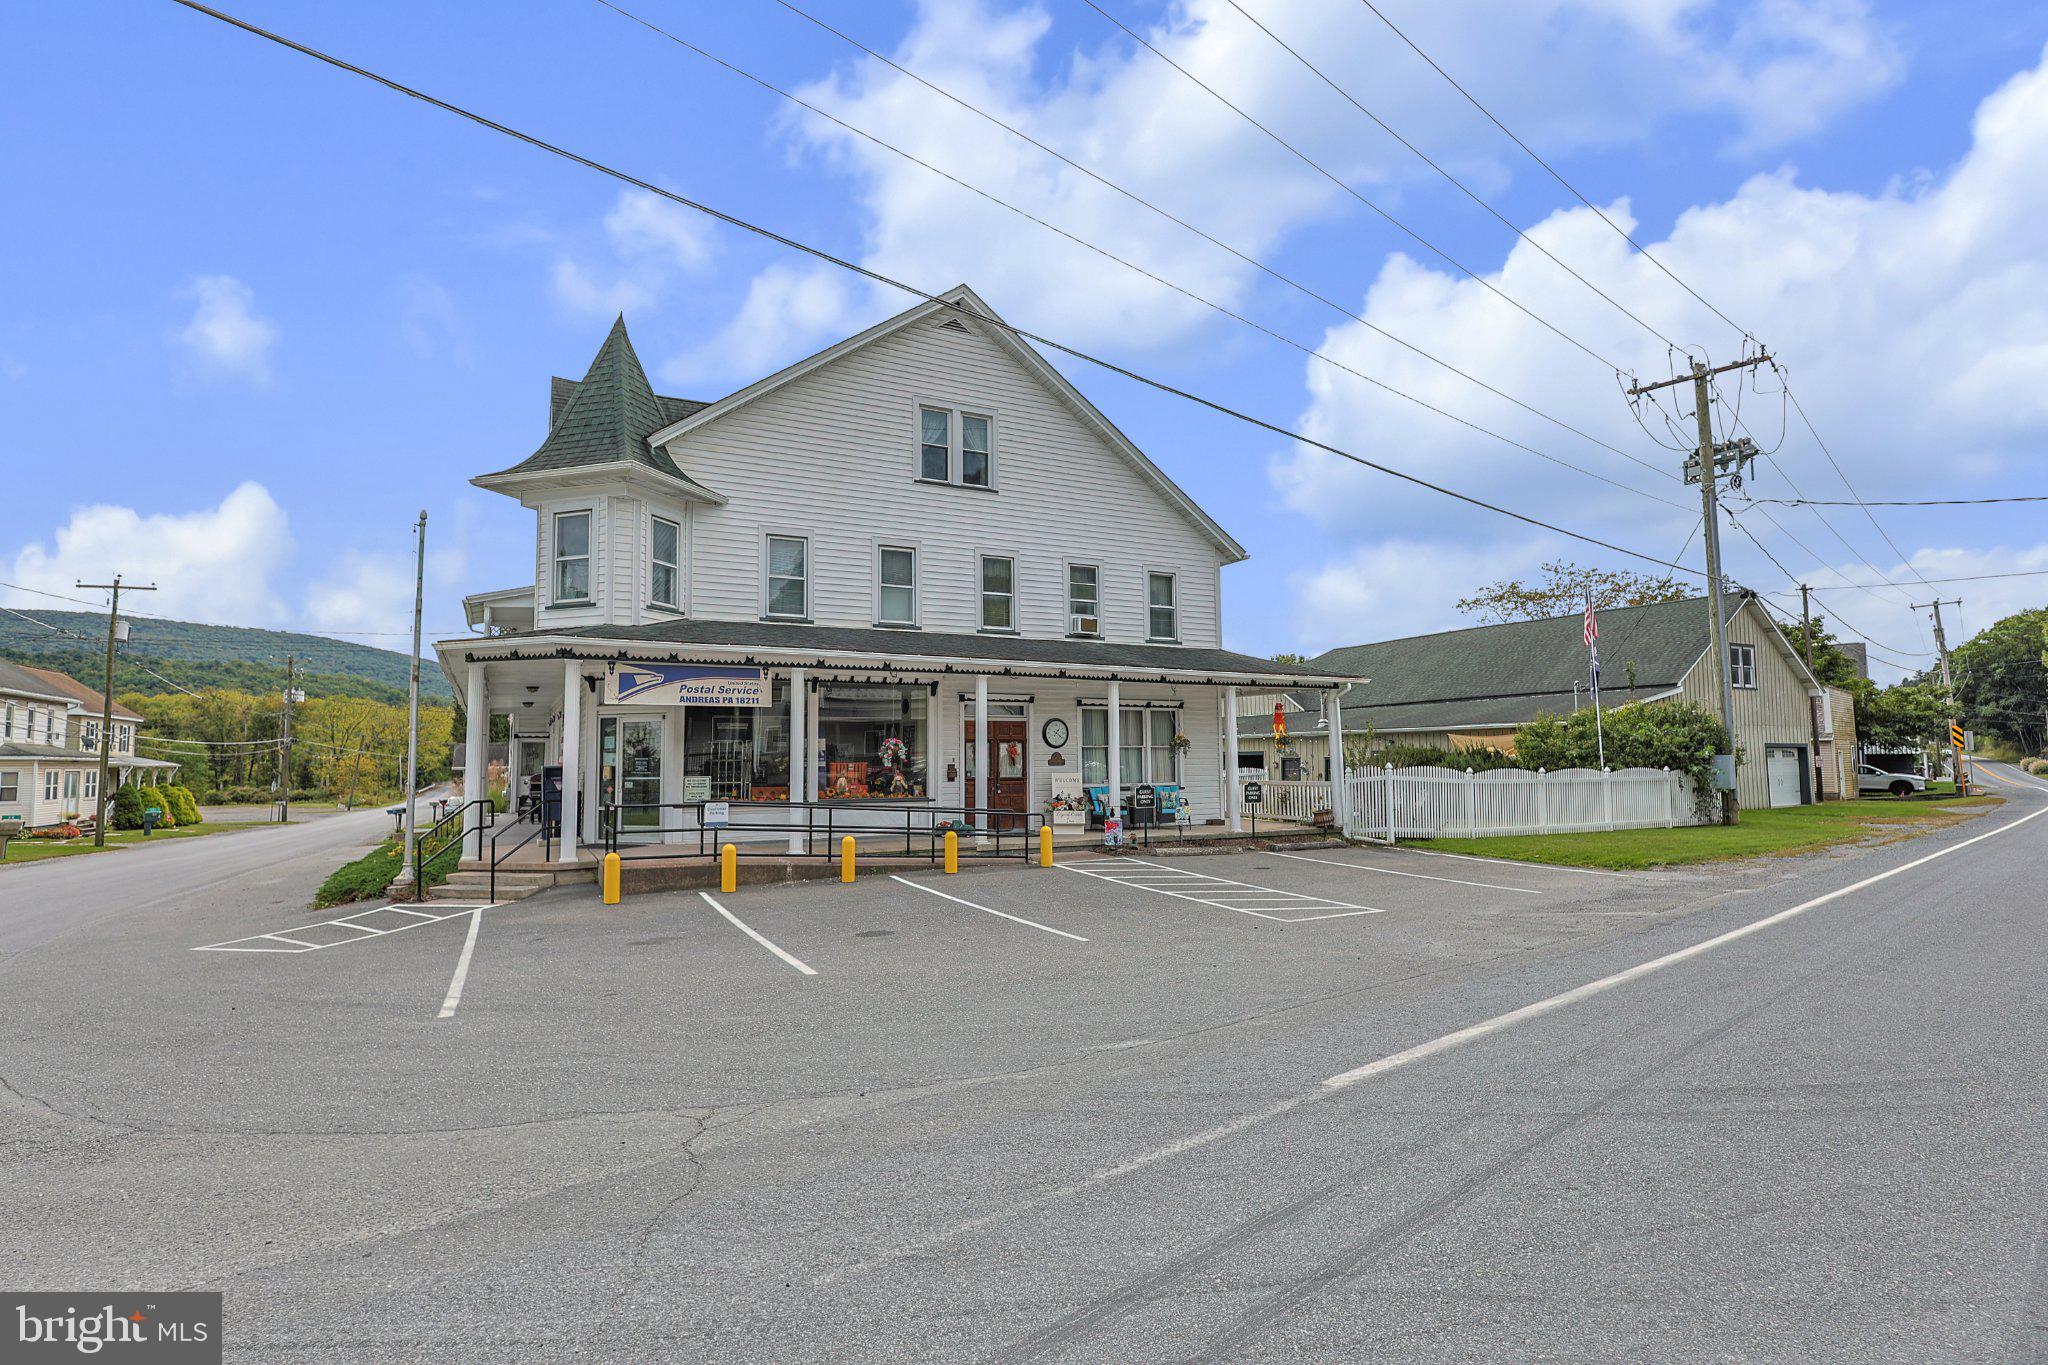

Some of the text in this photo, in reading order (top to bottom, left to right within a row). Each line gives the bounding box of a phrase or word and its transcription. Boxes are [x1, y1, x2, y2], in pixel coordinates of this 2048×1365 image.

[679, 684, 759, 695] Postal Service
[679, 696, 720, 704] ANDREAS
[722, 696, 733, 704] PA
